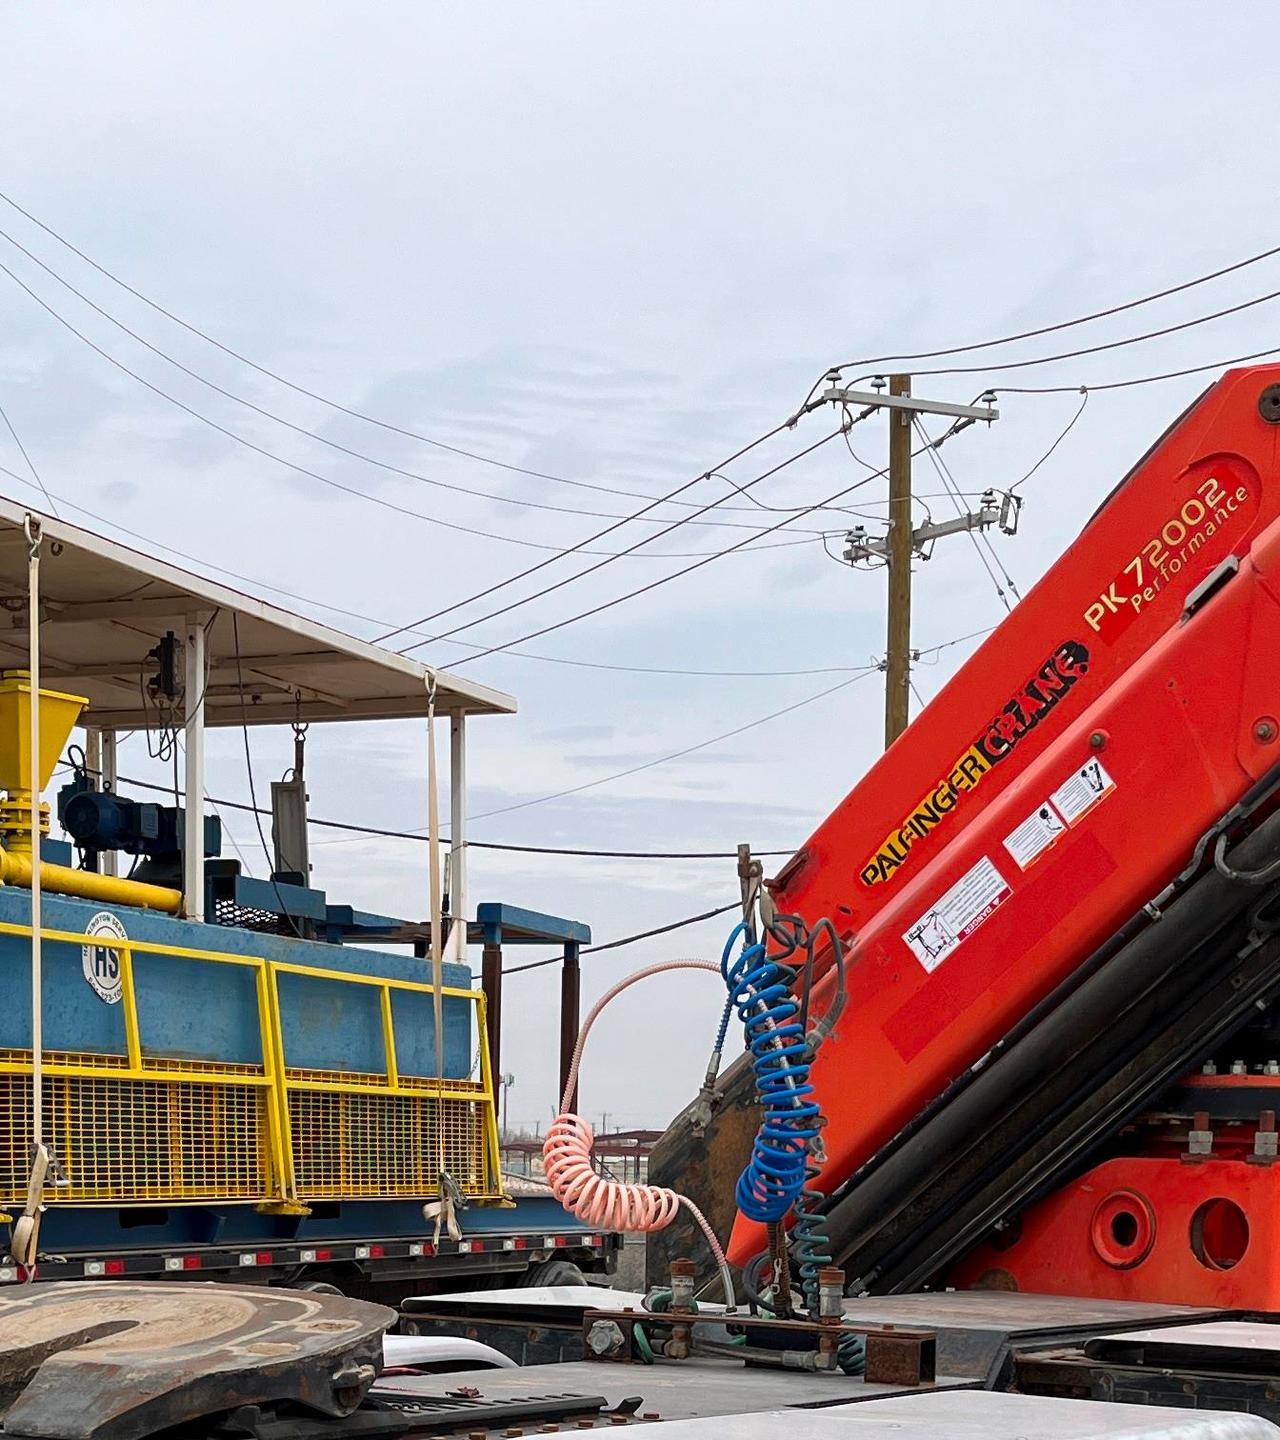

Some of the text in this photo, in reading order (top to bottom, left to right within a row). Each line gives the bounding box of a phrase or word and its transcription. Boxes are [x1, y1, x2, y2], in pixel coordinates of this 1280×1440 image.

[1083, 478, 1227, 632] PK 72002
[1131, 486, 1248, 613] Performance
[860, 754, 987, 886] PALFINGER
[95, 946, 119, 979] HS
[963, 906, 993, 935] DANGER
